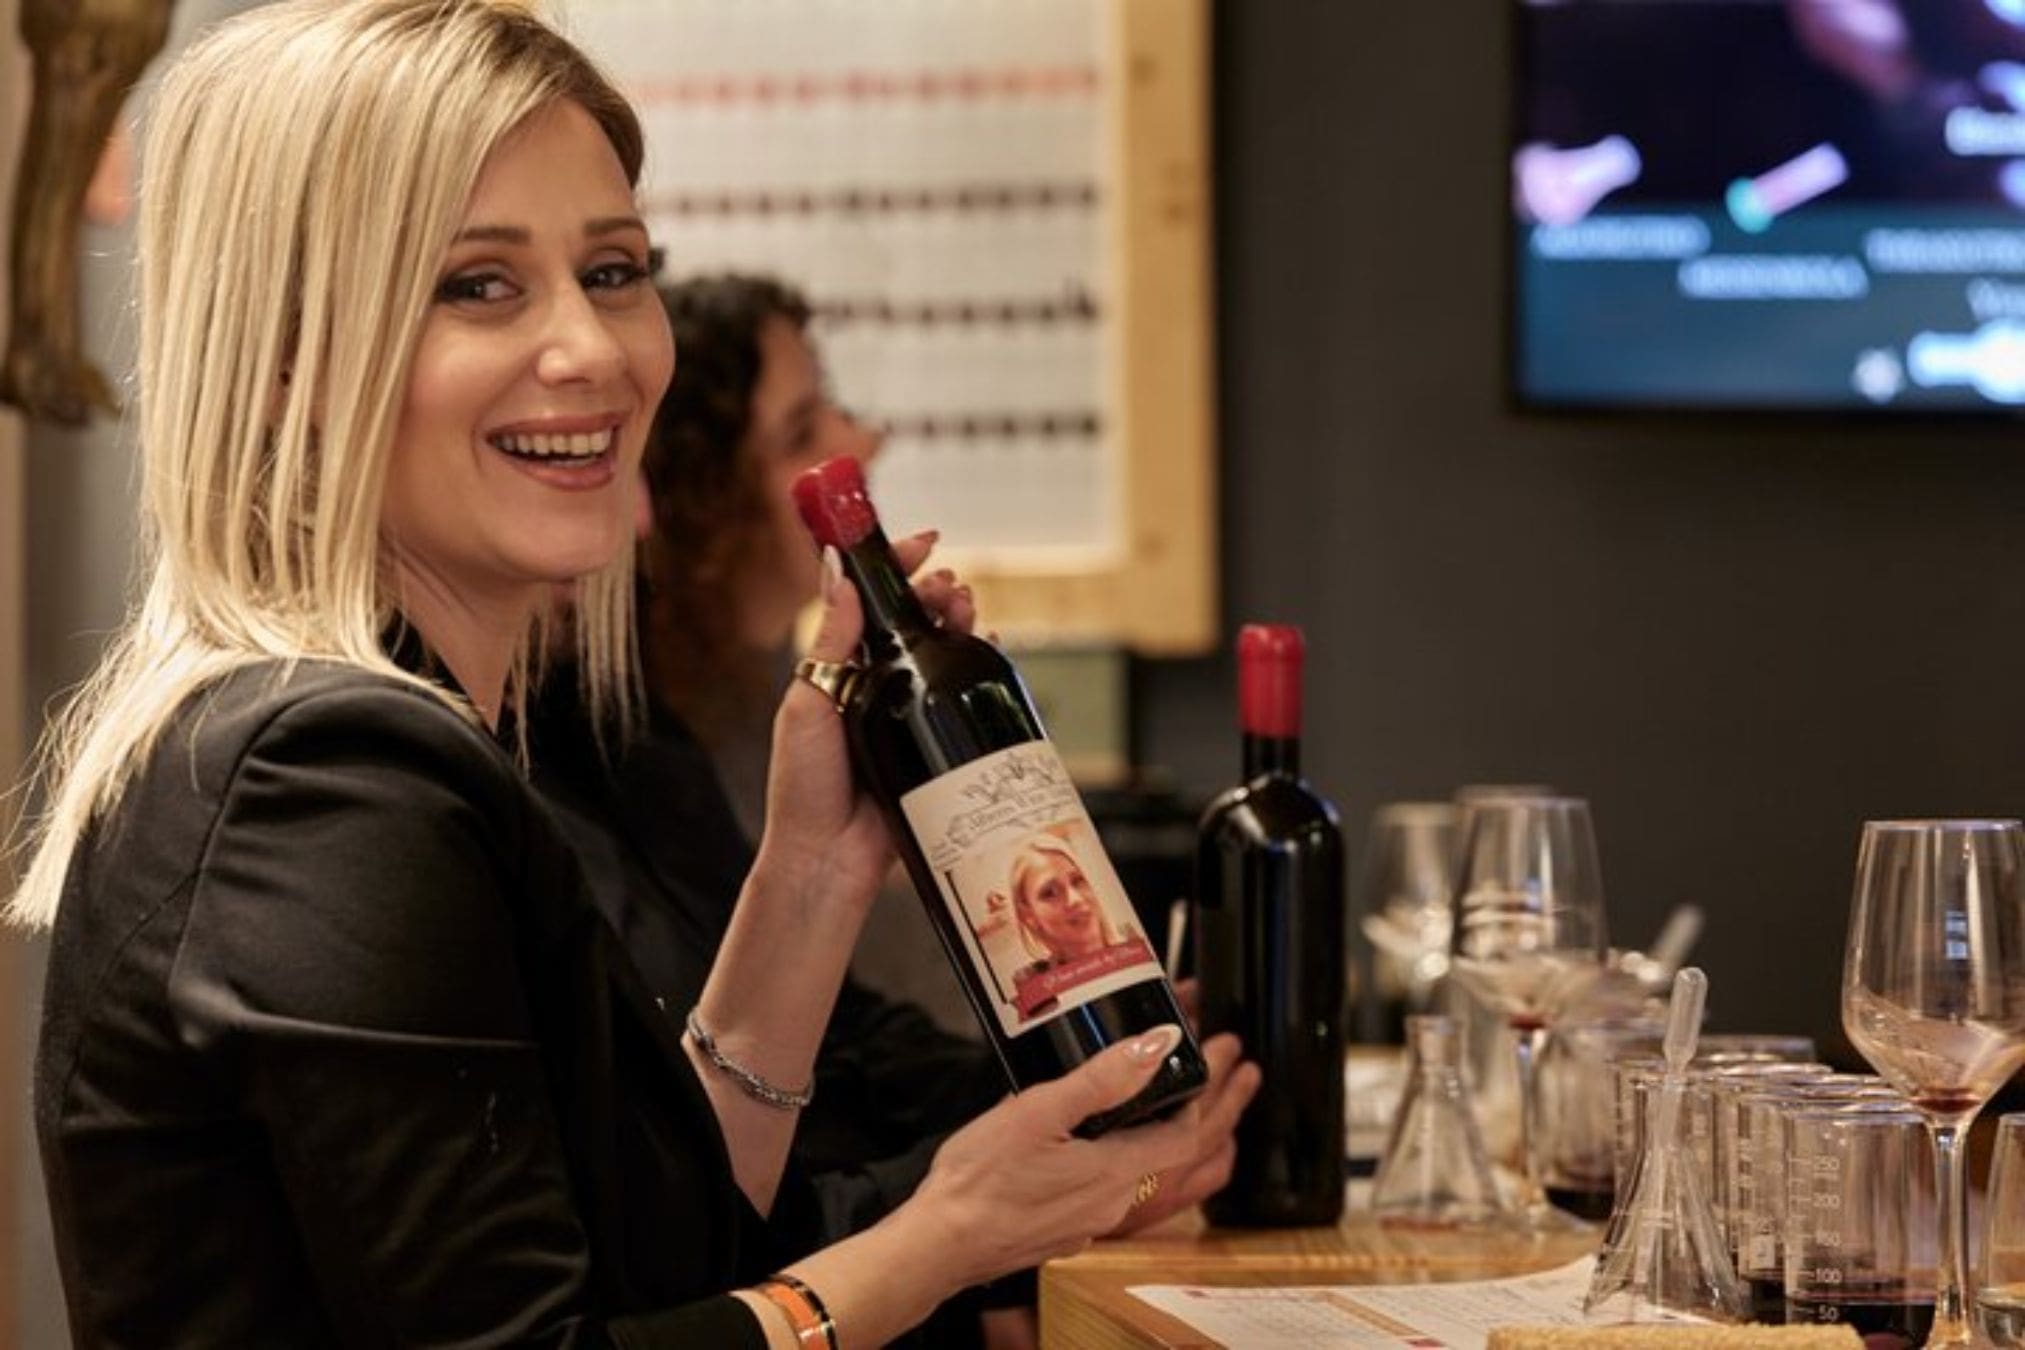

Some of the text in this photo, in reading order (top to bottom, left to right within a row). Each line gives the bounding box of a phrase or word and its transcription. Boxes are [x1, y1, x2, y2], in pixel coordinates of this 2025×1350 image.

[1813, 1193, 1840, 1209] 200
[1816, 1267, 1842, 1284] 100
[1818, 1304, 1839, 1321] 50
